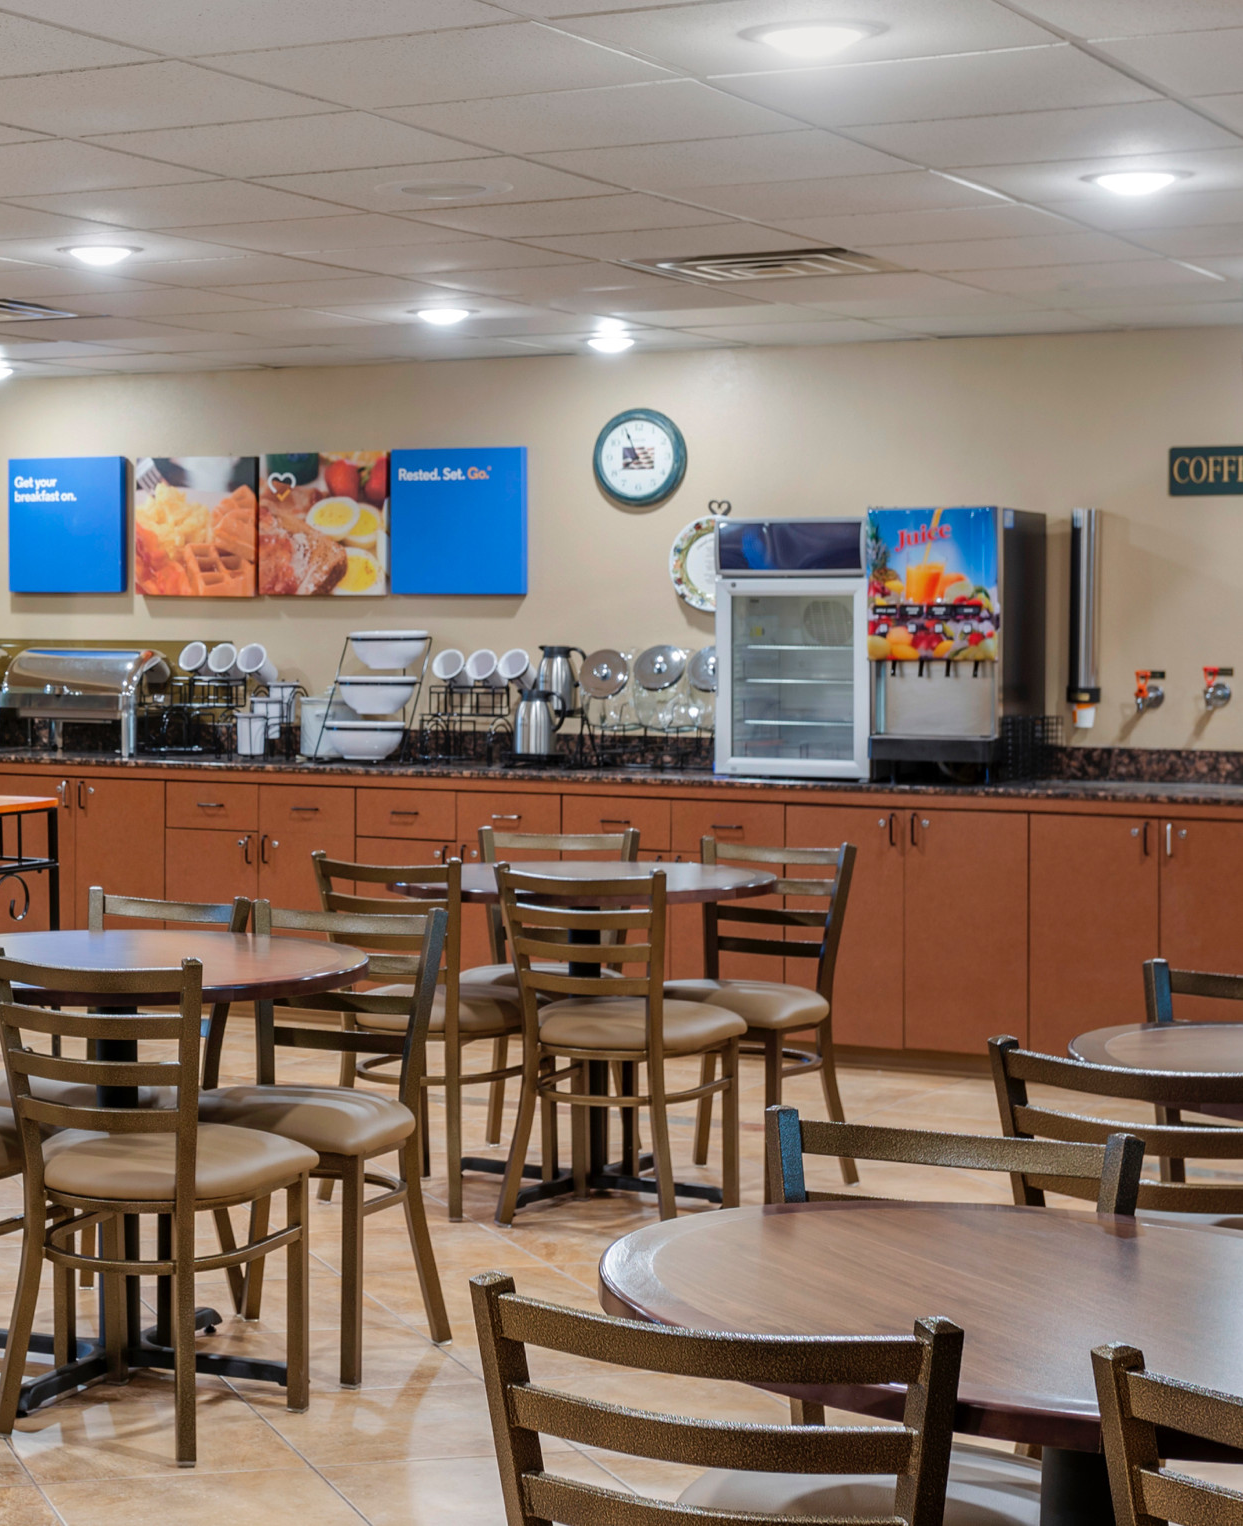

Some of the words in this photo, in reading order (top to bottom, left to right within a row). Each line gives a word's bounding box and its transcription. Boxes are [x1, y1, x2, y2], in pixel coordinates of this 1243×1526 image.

[398, 466, 441, 481] Rested.
[442, 466, 466, 480] Set.
[14, 476, 34, 489] Get
[35, 477, 58, 491] your
[14, 489, 60, 502] breakfast
[60, 492, 77, 501] on.
[894, 523, 952, 552] Juice
